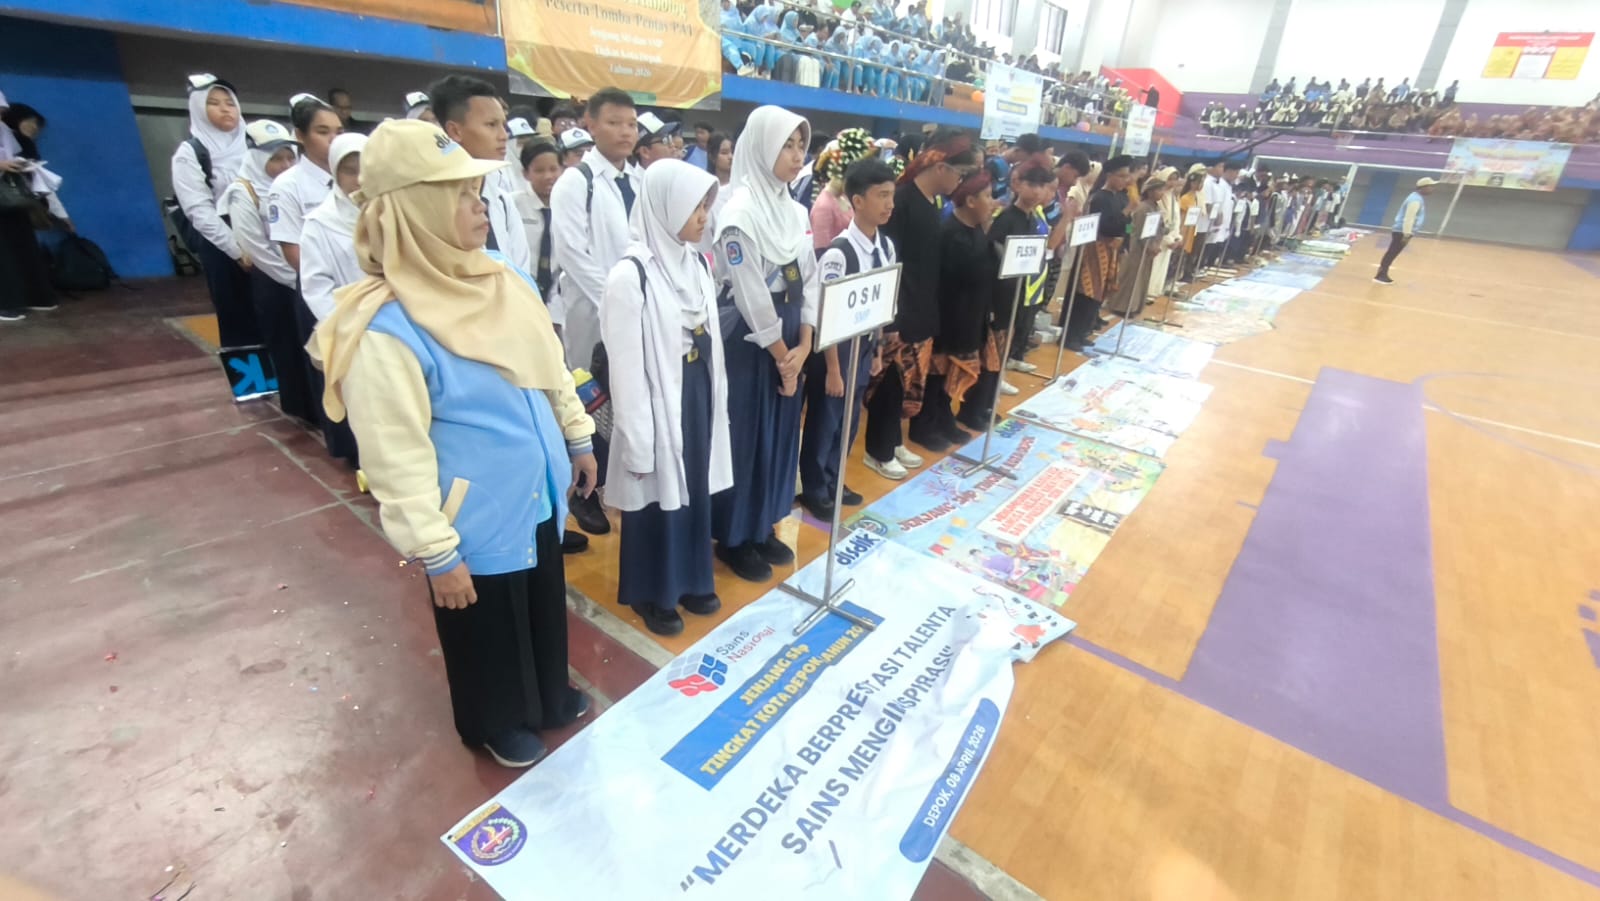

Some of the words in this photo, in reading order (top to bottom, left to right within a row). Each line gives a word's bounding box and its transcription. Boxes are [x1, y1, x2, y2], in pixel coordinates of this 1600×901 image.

[716, 628, 750, 656] Sains
[727, 625, 776, 663] Nasional
[893, 605, 956, 660] TALENTA
[700, 720, 760, 776] TINGKAT
[755, 692, 792, 723] KOTA
[784, 656, 822, 696] DEPOK
[820, 636, 853, 664] AHUN
[740, 658, 792, 706] JENJANG
[923, 788, 954, 828] DEPOK,
[946, 772, 961, 789] 08
[955, 748, 976, 777] APRIL
[968, 724, 986, 750] 2026
[781, 778, 851, 855] SAINS
